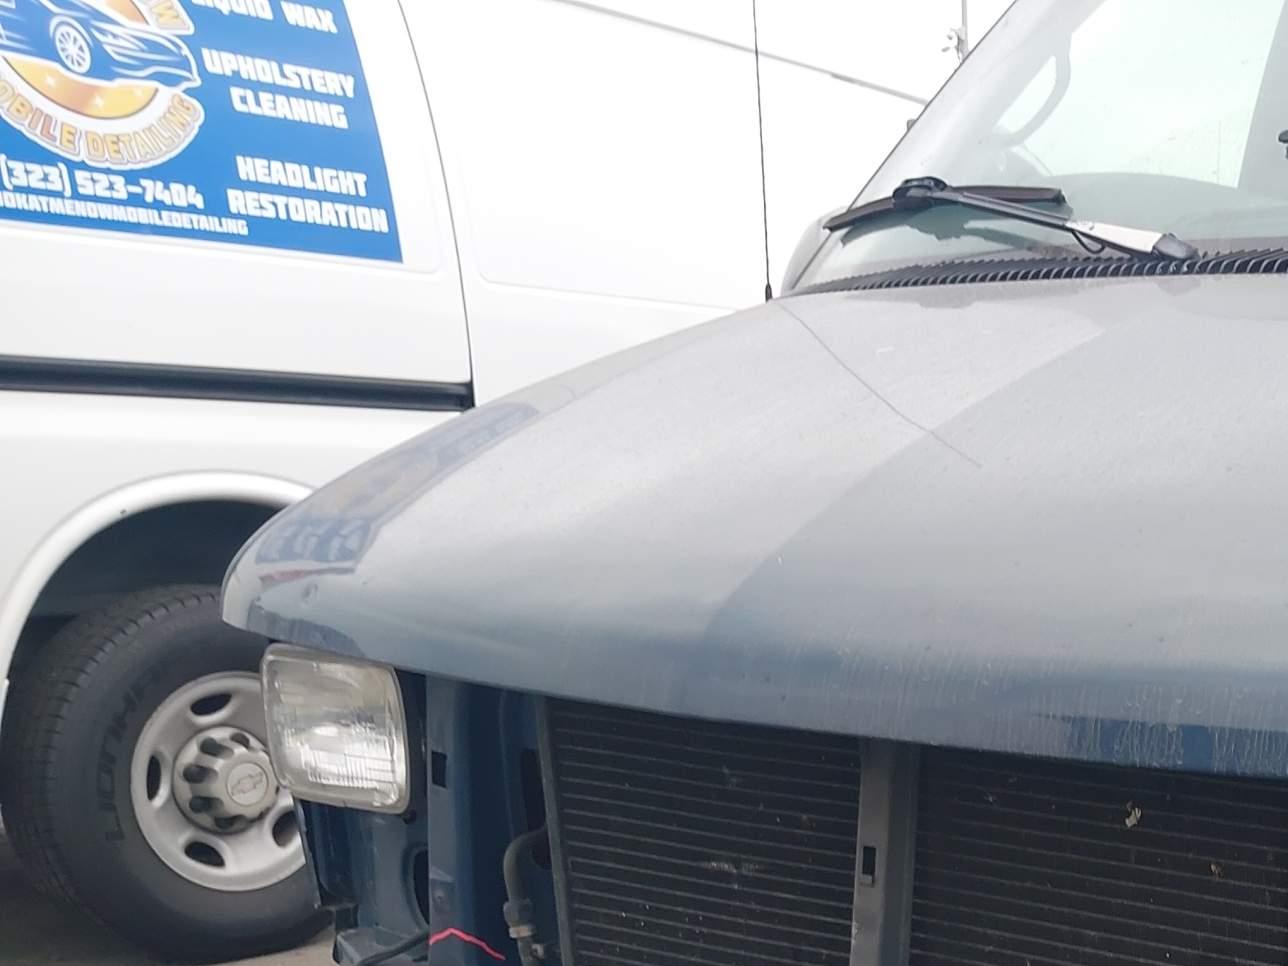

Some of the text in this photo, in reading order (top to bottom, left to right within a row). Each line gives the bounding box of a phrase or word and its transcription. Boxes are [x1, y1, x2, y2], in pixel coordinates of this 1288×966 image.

[280, 1, 338, 34] WAX
[201, 47, 355, 98] UPHOLSTERY
[0, 78, 199, 161] OBILE DETAILING
[229, 86, 348, 129] CLEANING
[0, 152, 205, 209] (323) 523-7404
[235, 155, 367, 197] HEADLIGHT
[226, 188, 389, 233] RESTORATION
